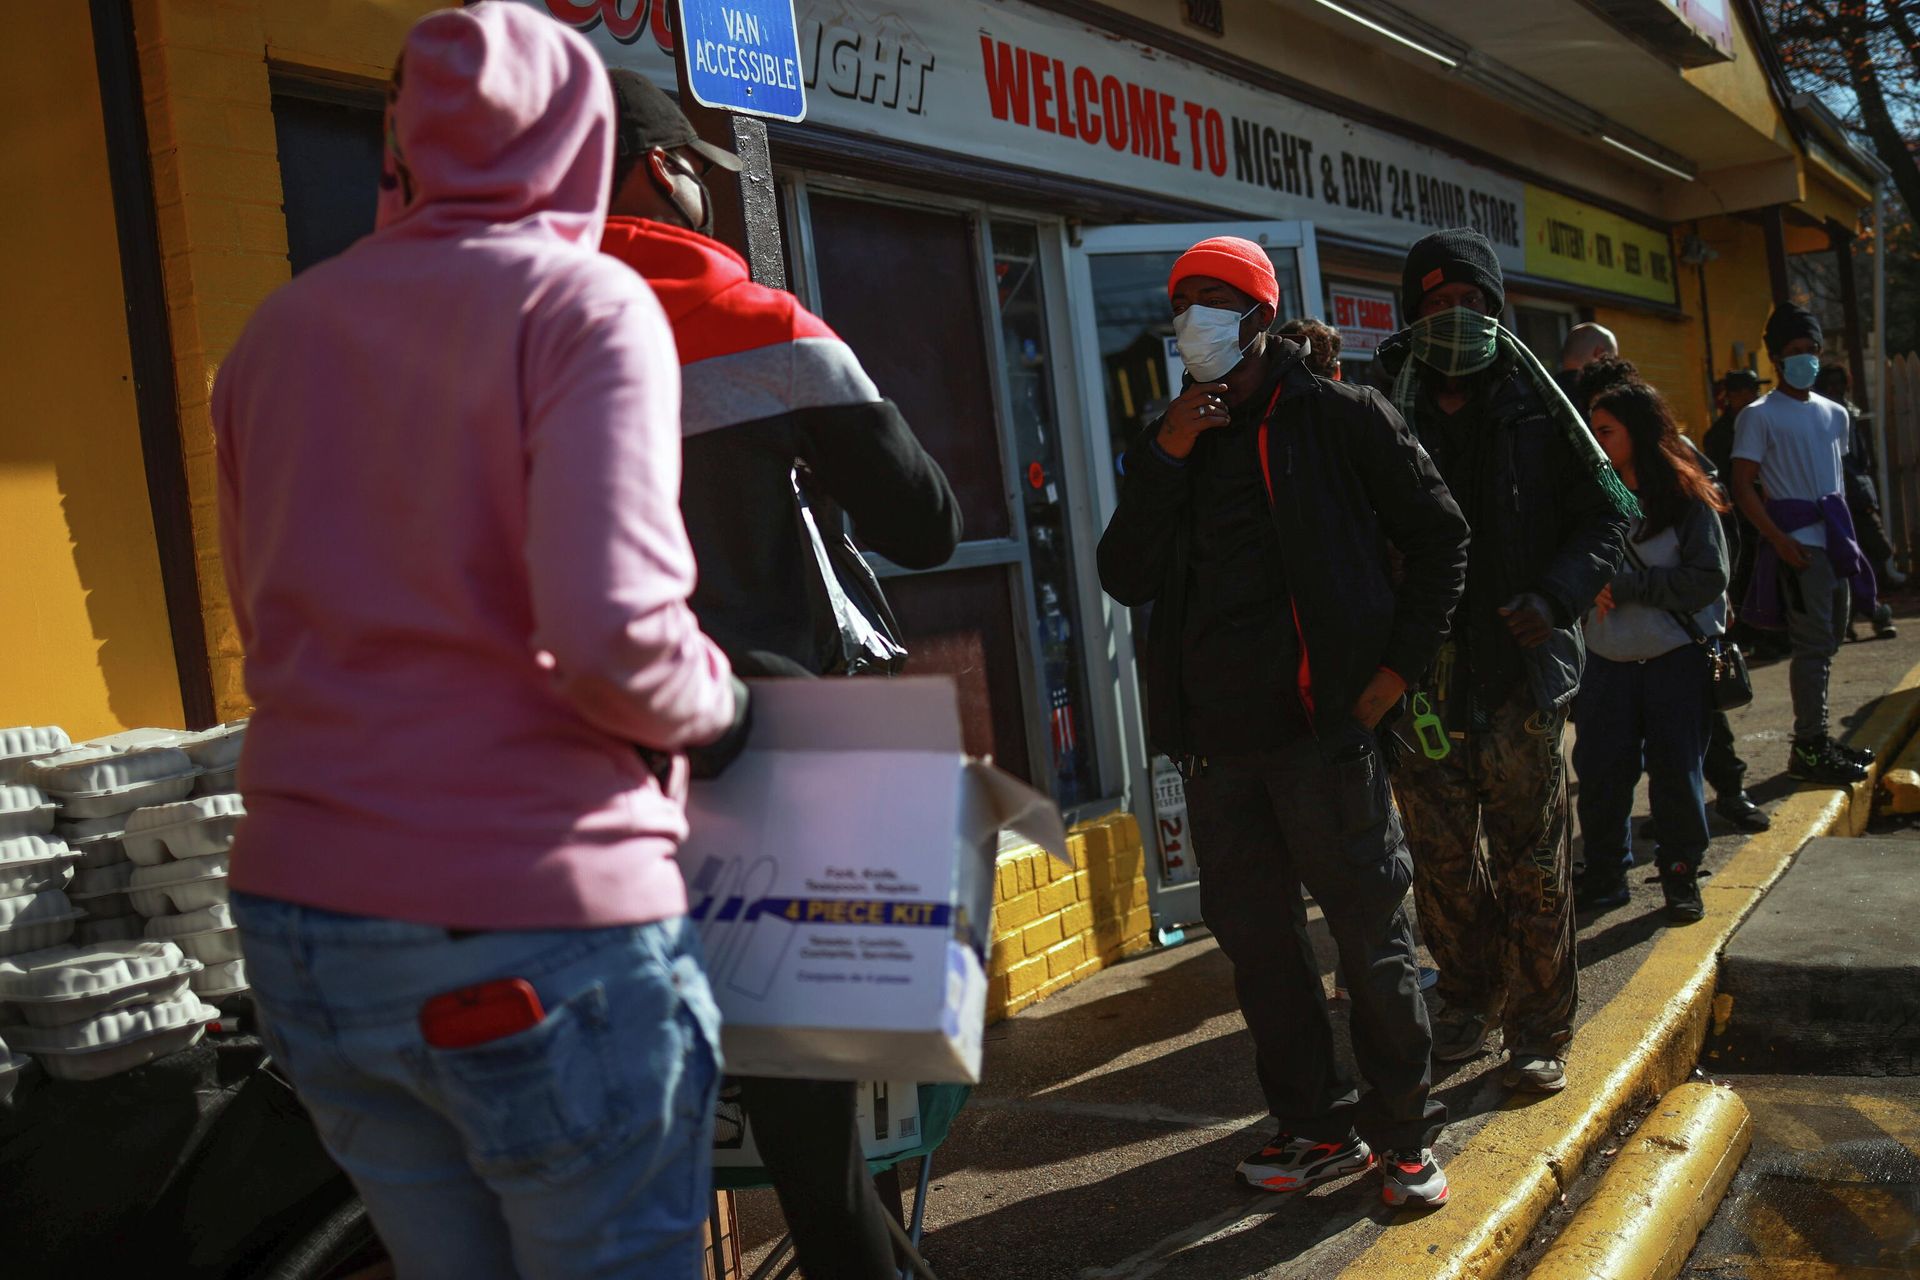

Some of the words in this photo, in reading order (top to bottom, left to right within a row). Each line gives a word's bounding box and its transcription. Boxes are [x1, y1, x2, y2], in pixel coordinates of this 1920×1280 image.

[722, 7, 761, 46] VAN
[696, 42, 797, 91] ACCESSIBLE
[803, 18, 935, 116] IGHT
[979, 35, 1181, 166] WELCOME
[1183, 100, 1228, 178] TO
[1231, 115, 1315, 199] NIGHT
[1320, 153, 1340, 206] &
[1341, 151, 1384, 215] DAY
[1387, 164, 1416, 225] 24
[1416, 172, 1469, 229] HOUR
[1470, 189, 1520, 248] STORE
[784, 901, 800, 920] 4
[806, 900, 885, 924] PIECE
[891, 904, 935, 925] KIT
